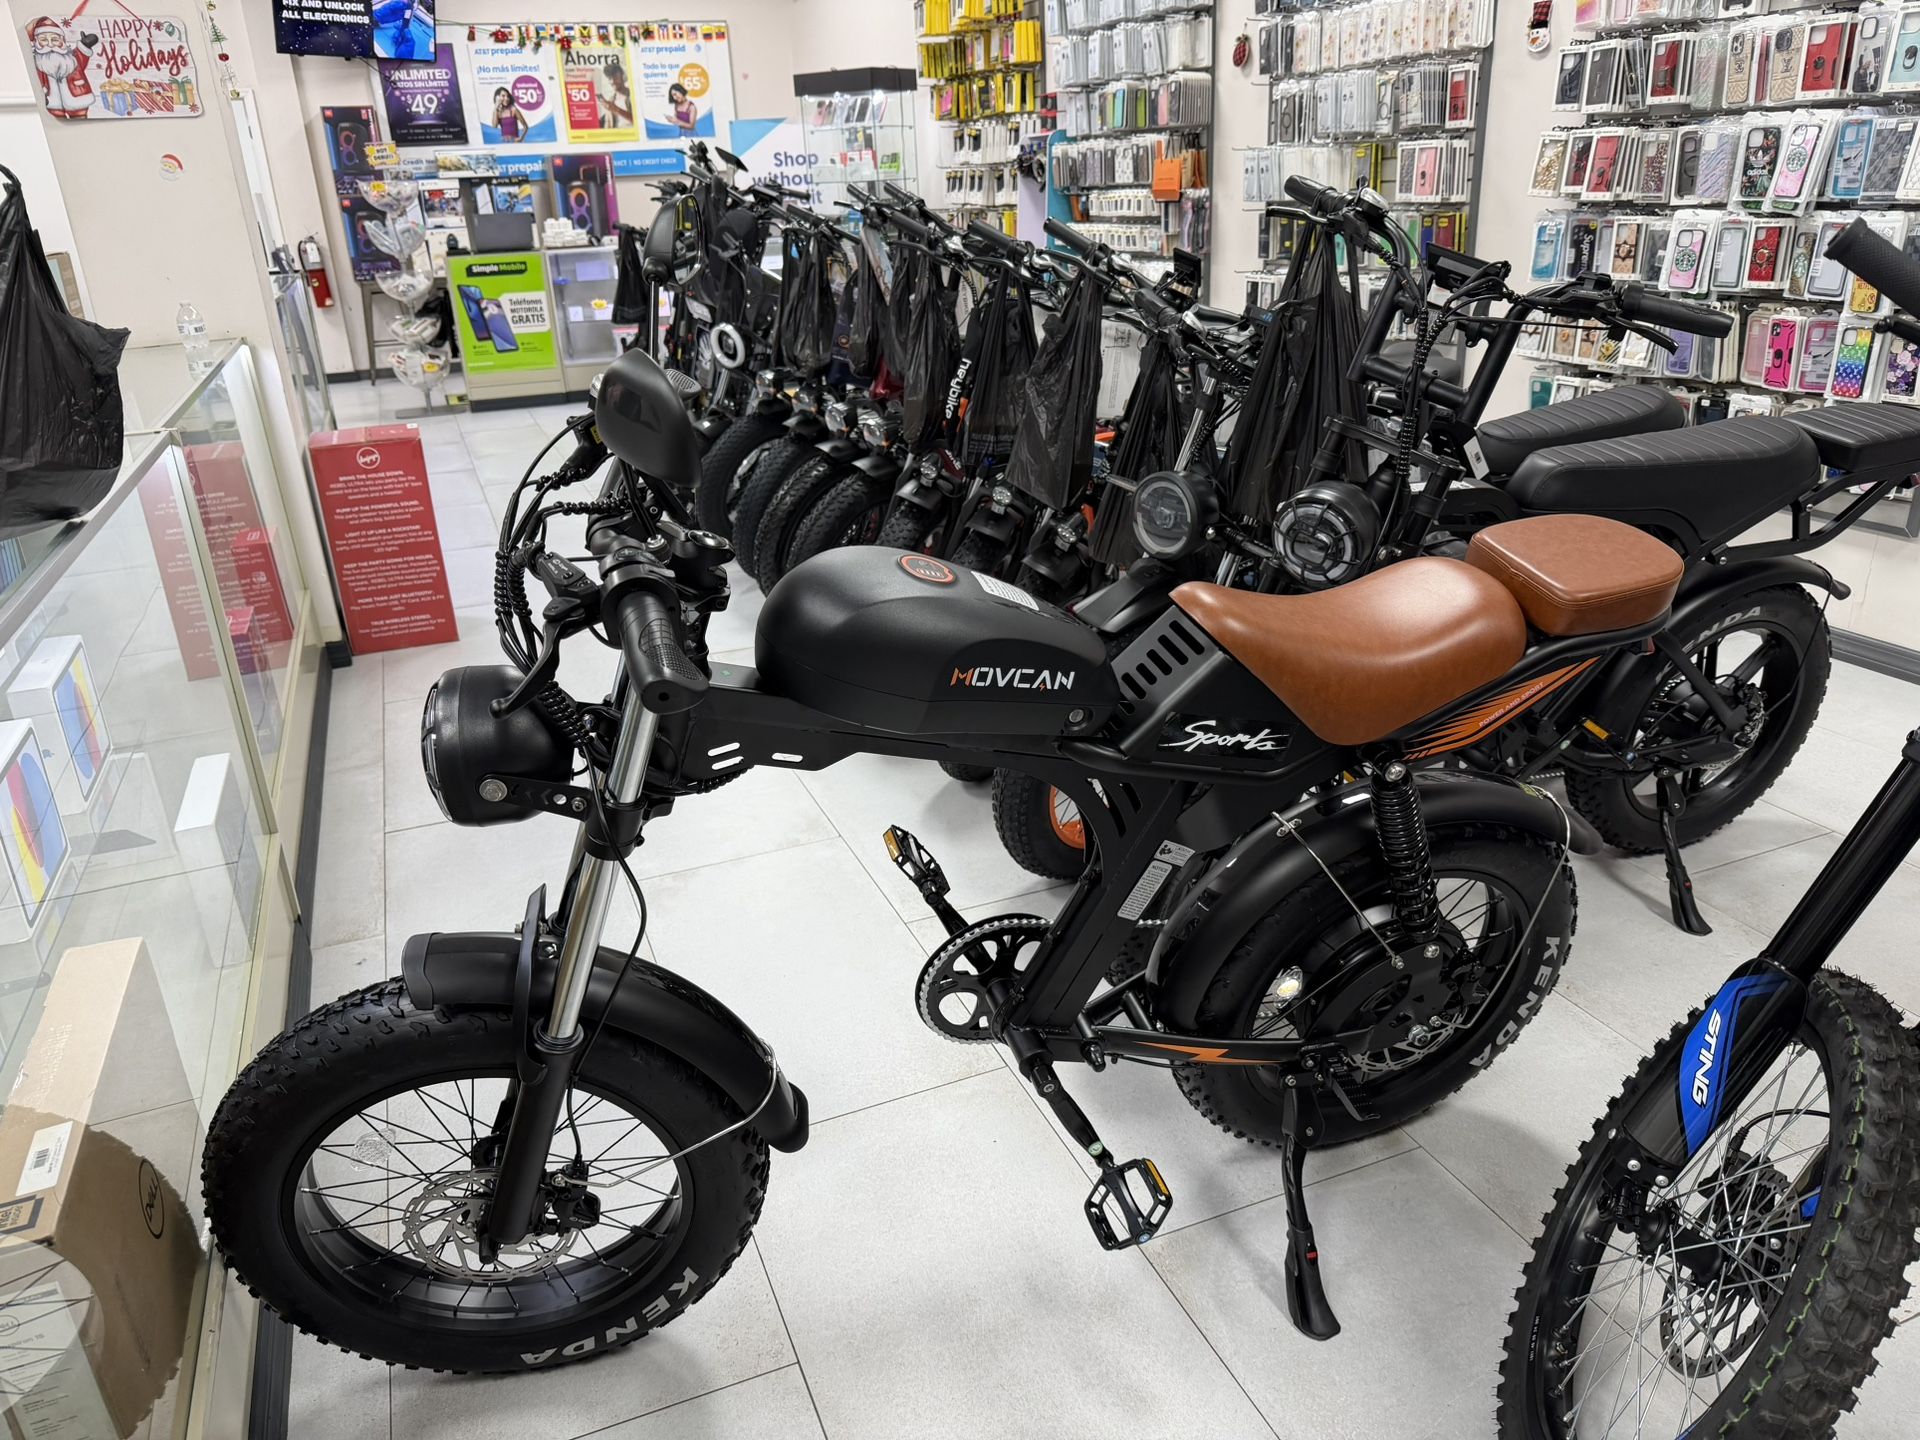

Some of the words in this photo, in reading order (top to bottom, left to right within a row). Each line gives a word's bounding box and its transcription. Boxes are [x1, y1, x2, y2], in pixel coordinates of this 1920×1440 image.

[302, 0, 323, 10] AND
[325, 1, 365, 12] UNLOCK
[282, 10, 301, 19] ALL
[304, 12, 370, 24] ELECTRONICS
[98, 19, 154, 40] HAPPY
[491, 47, 523, 56] prepaid
[564, 50, 620, 66] Ahorra
[656, 45, 686, 54] prepaid
[97, 38, 188, 79] Holidays
[668, 63, 680, 71] que
[492, 64, 510, 73] más
[406, 92, 438, 115] $49
[642, 158, 660, 166] CREDIT
[660, 157, 677, 165] CHECK
[773, 151, 819, 170] Shop
[1746, 168, 1769, 176] adidas
[1579, 233, 1595, 274] Suprem
[472, 264, 497, 273] Simple
[499, 263, 525, 272] Mobile
[509, 297, 543, 306] Teléfonos
[510, 306, 544, 315] MOTOROLA
[511, 313, 546, 325] GRATIS
[944, 357, 973, 420] heybike
[950, 666, 1076, 691] MOVCAN
[1478, 707, 1505, 727] POWER
[1505, 697, 1521, 712] AND
[1521, 681, 1545, 701] SPORT
[1159, 719, 1291, 754] Sports
[1469, 935, 1563, 1068] KENDA
[1692, 1007, 1721, 1107] STING
[147, 1176, 160, 1223] DELL
[519, 1266, 700, 1366] KENDA
